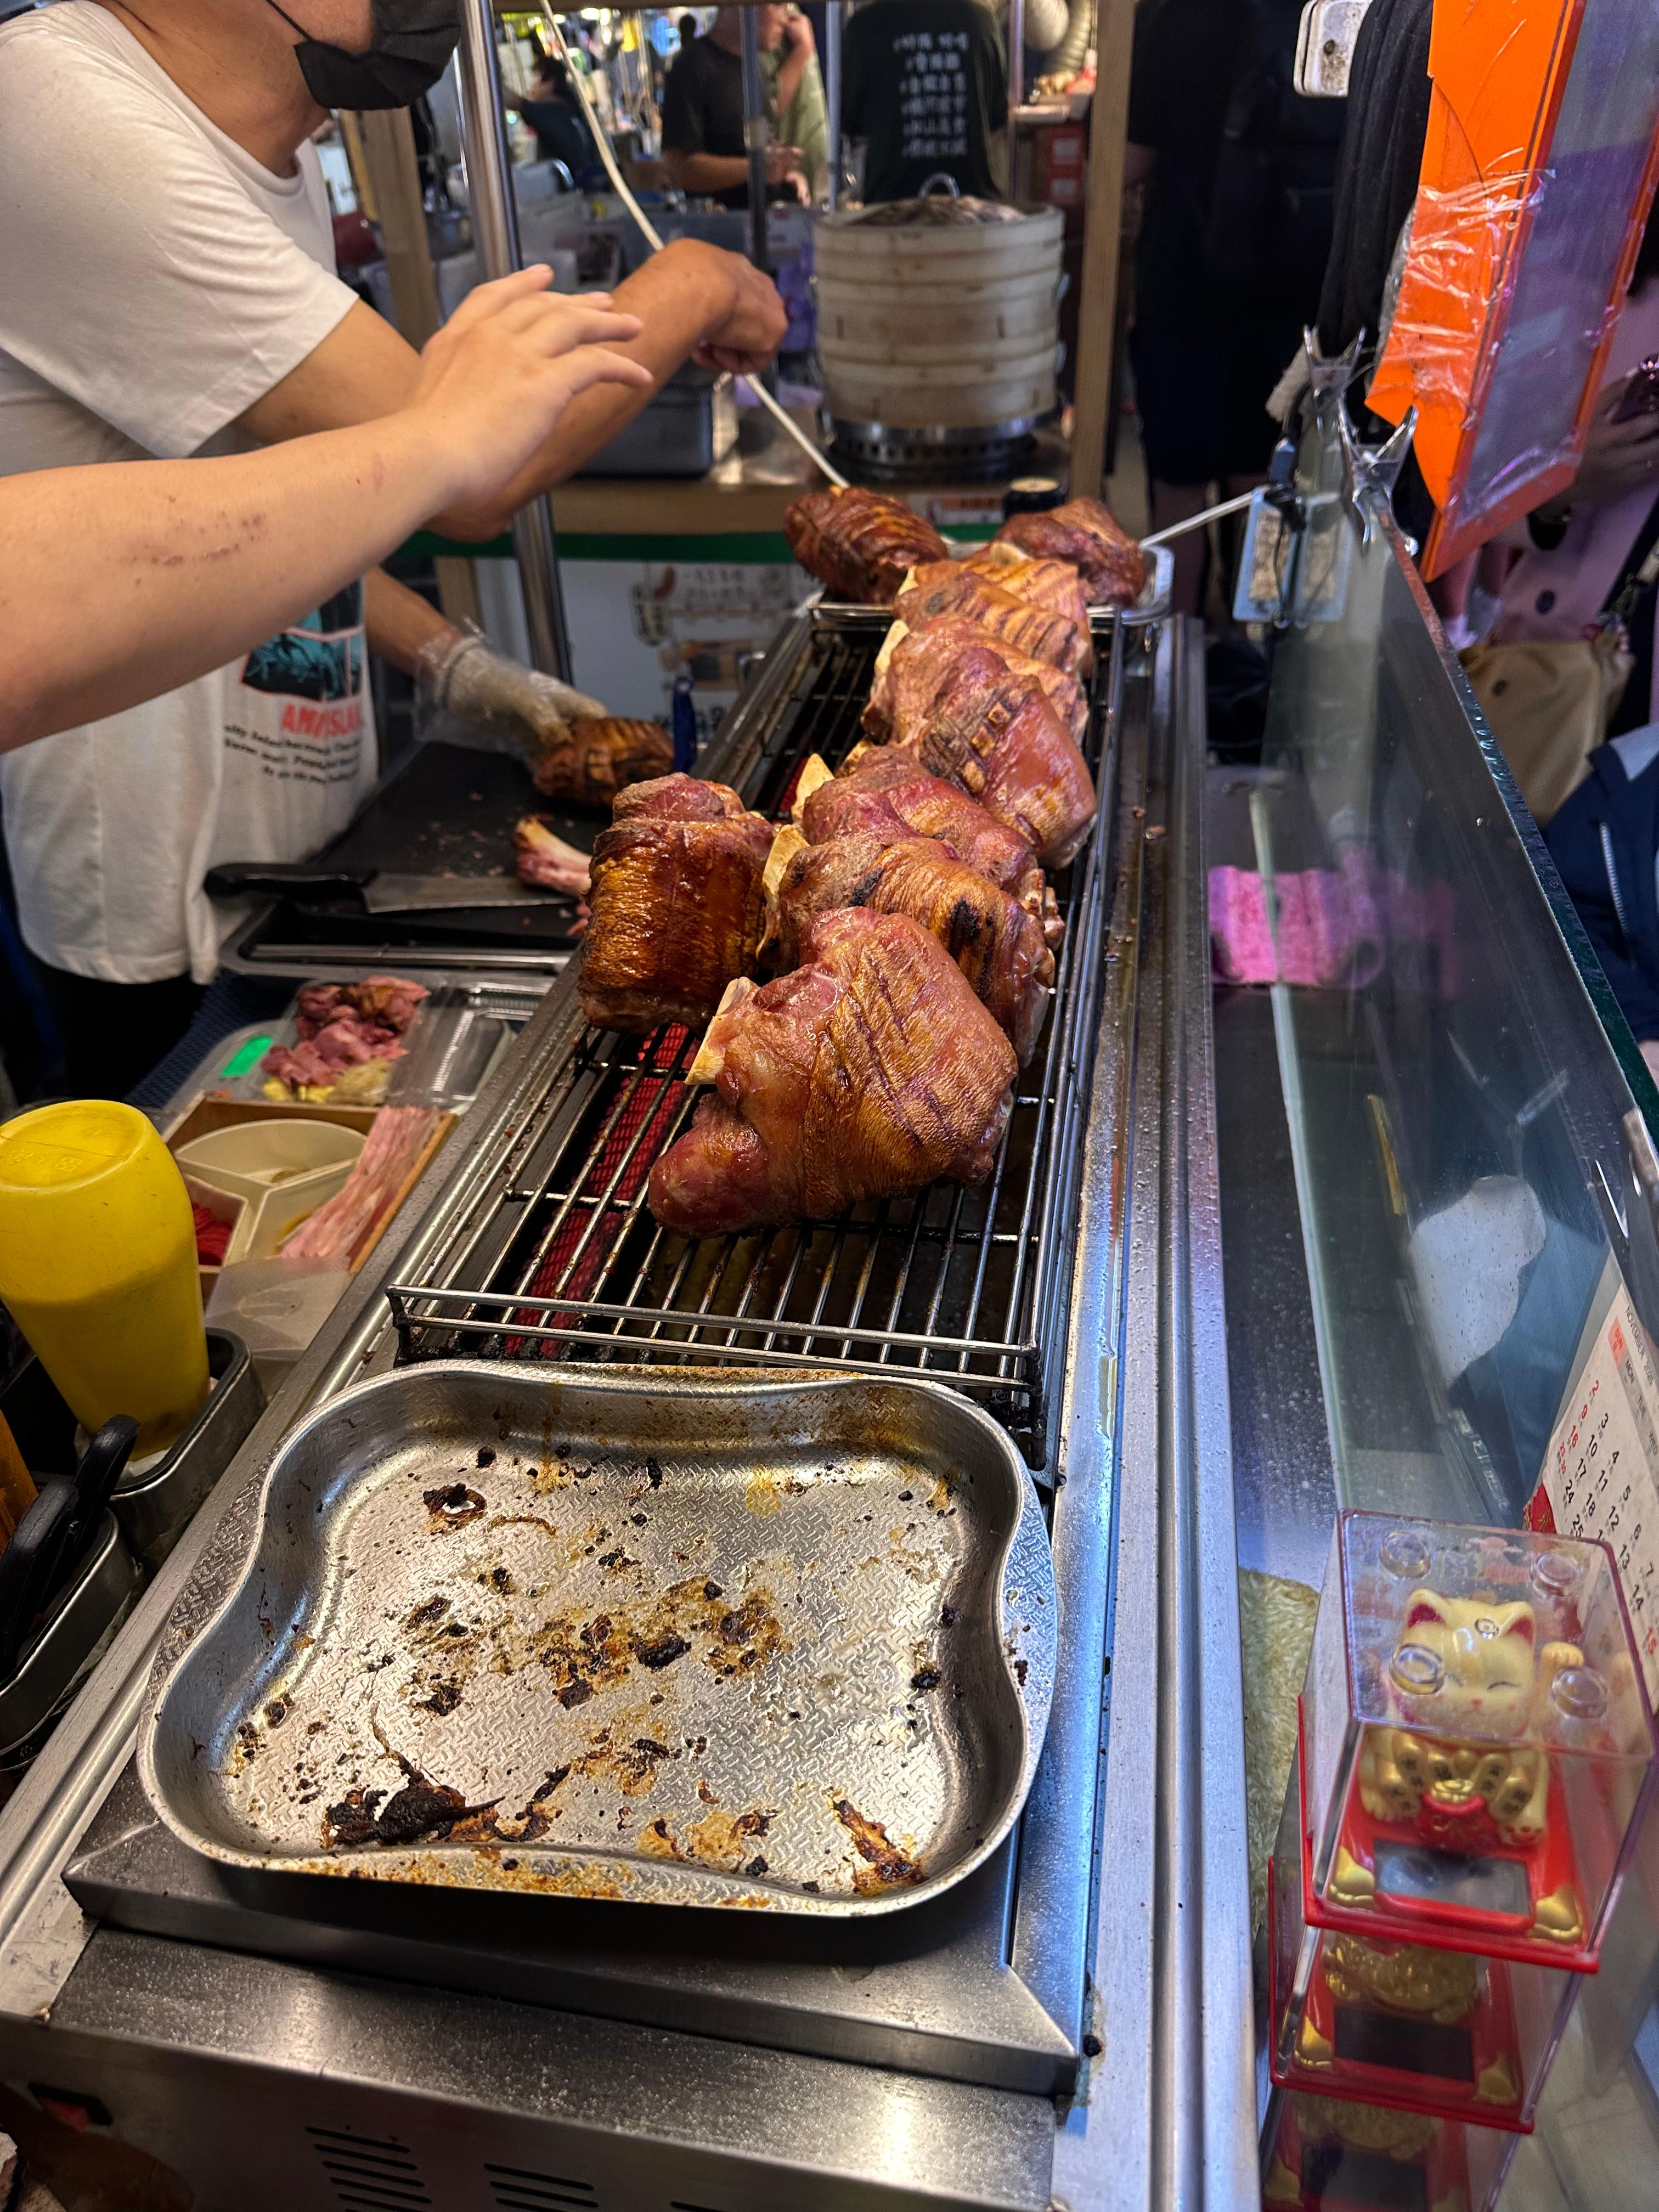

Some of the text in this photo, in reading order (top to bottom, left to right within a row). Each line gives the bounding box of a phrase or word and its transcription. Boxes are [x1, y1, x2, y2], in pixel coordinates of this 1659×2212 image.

[1615, 1328, 1658, 1455] SUN MON TUE WED
[1626, 1306, 1654, 1386] NOVEMBER 2025
[1565, 1479, 1575, 1504] 24
[1572, 1514, 1584, 1537] 25
[1570, 1425, 1578, 1448] 16
[1578, 1457, 1586, 1478] 17
[1586, 1493, 1596, 1517] 18
[1592, 1379, 1654, 1577] 2 3 4 5 6 7
[1581, 1404, 1588, 1419] 9
[1588, 1434, 1598, 1457] 10
[1599, 1470, 1608, 1492] 11
[1609, 1505, 1619, 1532] 12
[1620, 1544, 1629, 1570] 13
[1632, 1584, 1644, 1611] 14
[1645, 1626, 1657, 1656] 15
